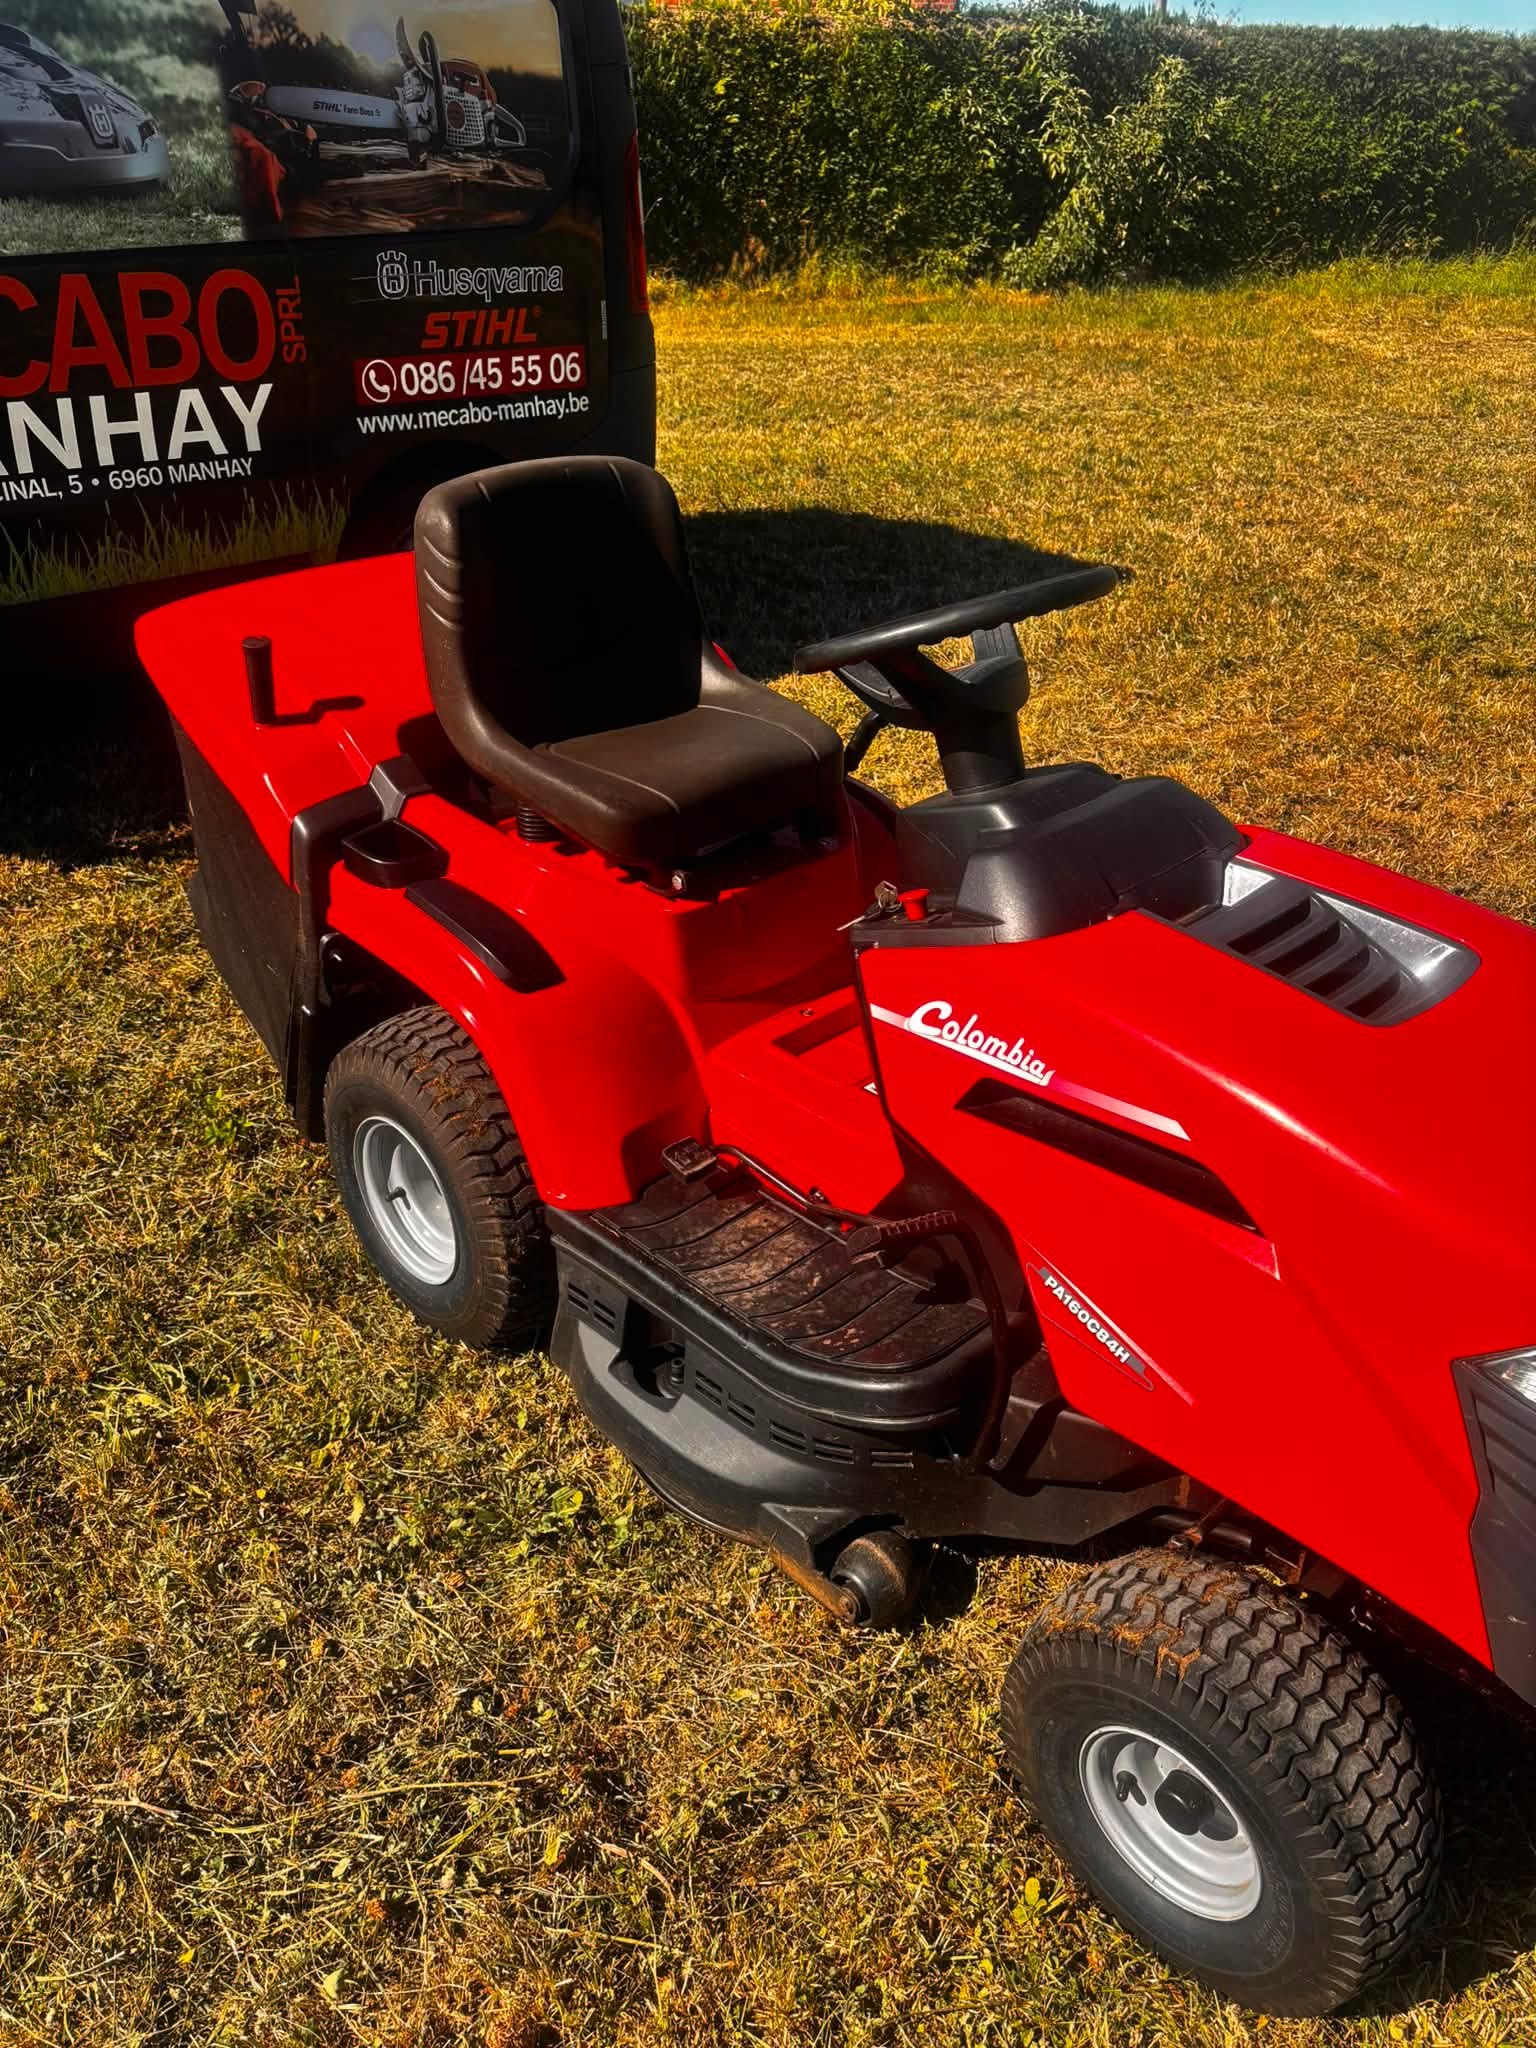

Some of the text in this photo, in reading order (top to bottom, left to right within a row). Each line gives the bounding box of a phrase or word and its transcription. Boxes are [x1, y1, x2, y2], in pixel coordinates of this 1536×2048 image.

[414, 261, 564, 302] Husqvarna
[276, 275, 306, 364] SPRL
[421, 308, 537, 349] STIHL
[400, 361, 456, 396] 086
[511, 355, 542, 387] 55
[549, 352, 581, 384] 06
[0, 383, 273, 477] NHAY
[356, 392, 589, 434] www.mecabo-manhay.be
[0, 457, 252, 502] INAL, 5 6960 MANHAY
[906, 1000, 1054, 1084] Colombia
